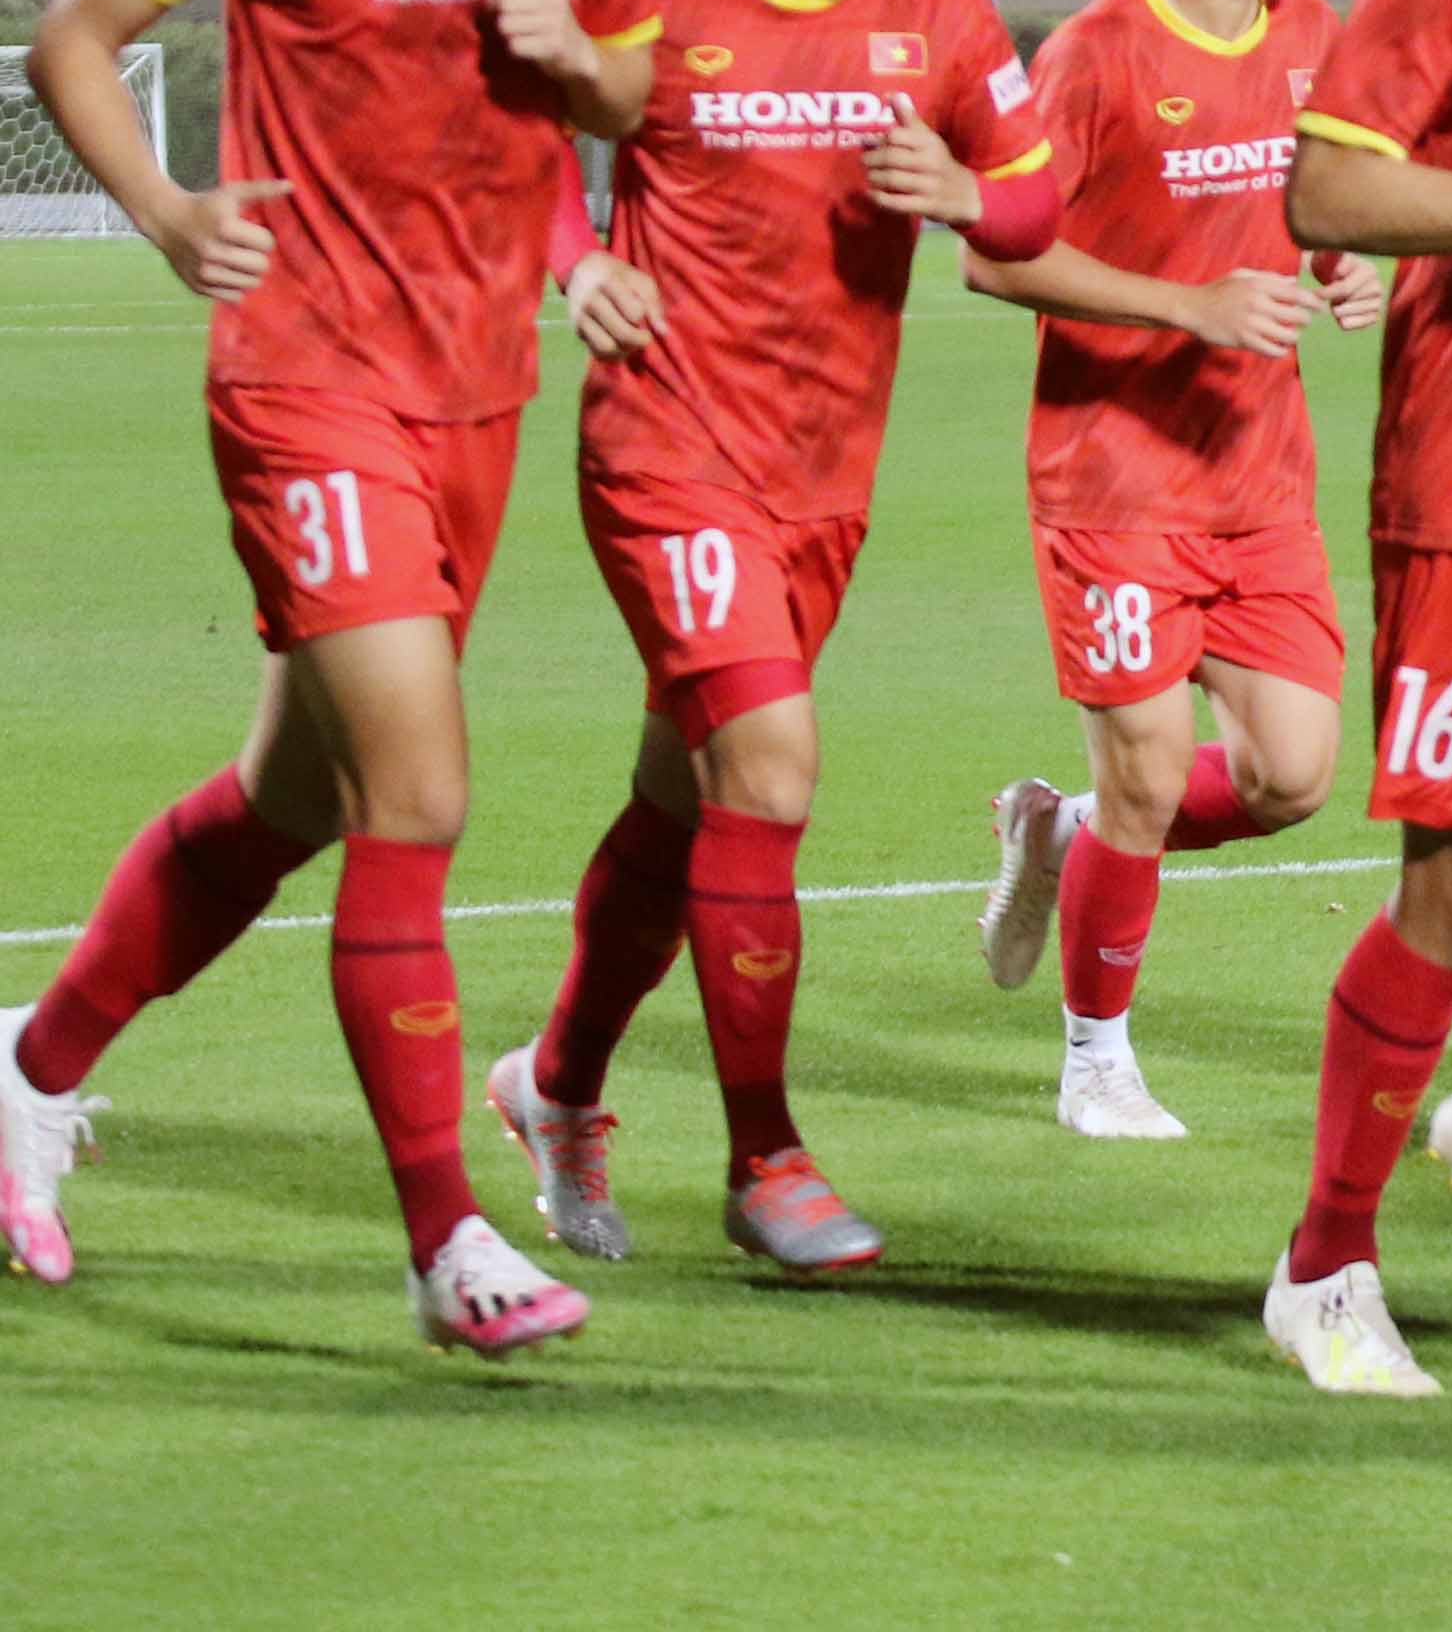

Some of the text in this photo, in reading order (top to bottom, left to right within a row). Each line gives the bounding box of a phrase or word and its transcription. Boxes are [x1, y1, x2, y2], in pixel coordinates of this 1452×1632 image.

[1161, 136, 1297, 179] HOND
[285, 470, 370, 586] 31
[661, 527, 735, 633] 19
[1084, 582, 1153, 673] 38
